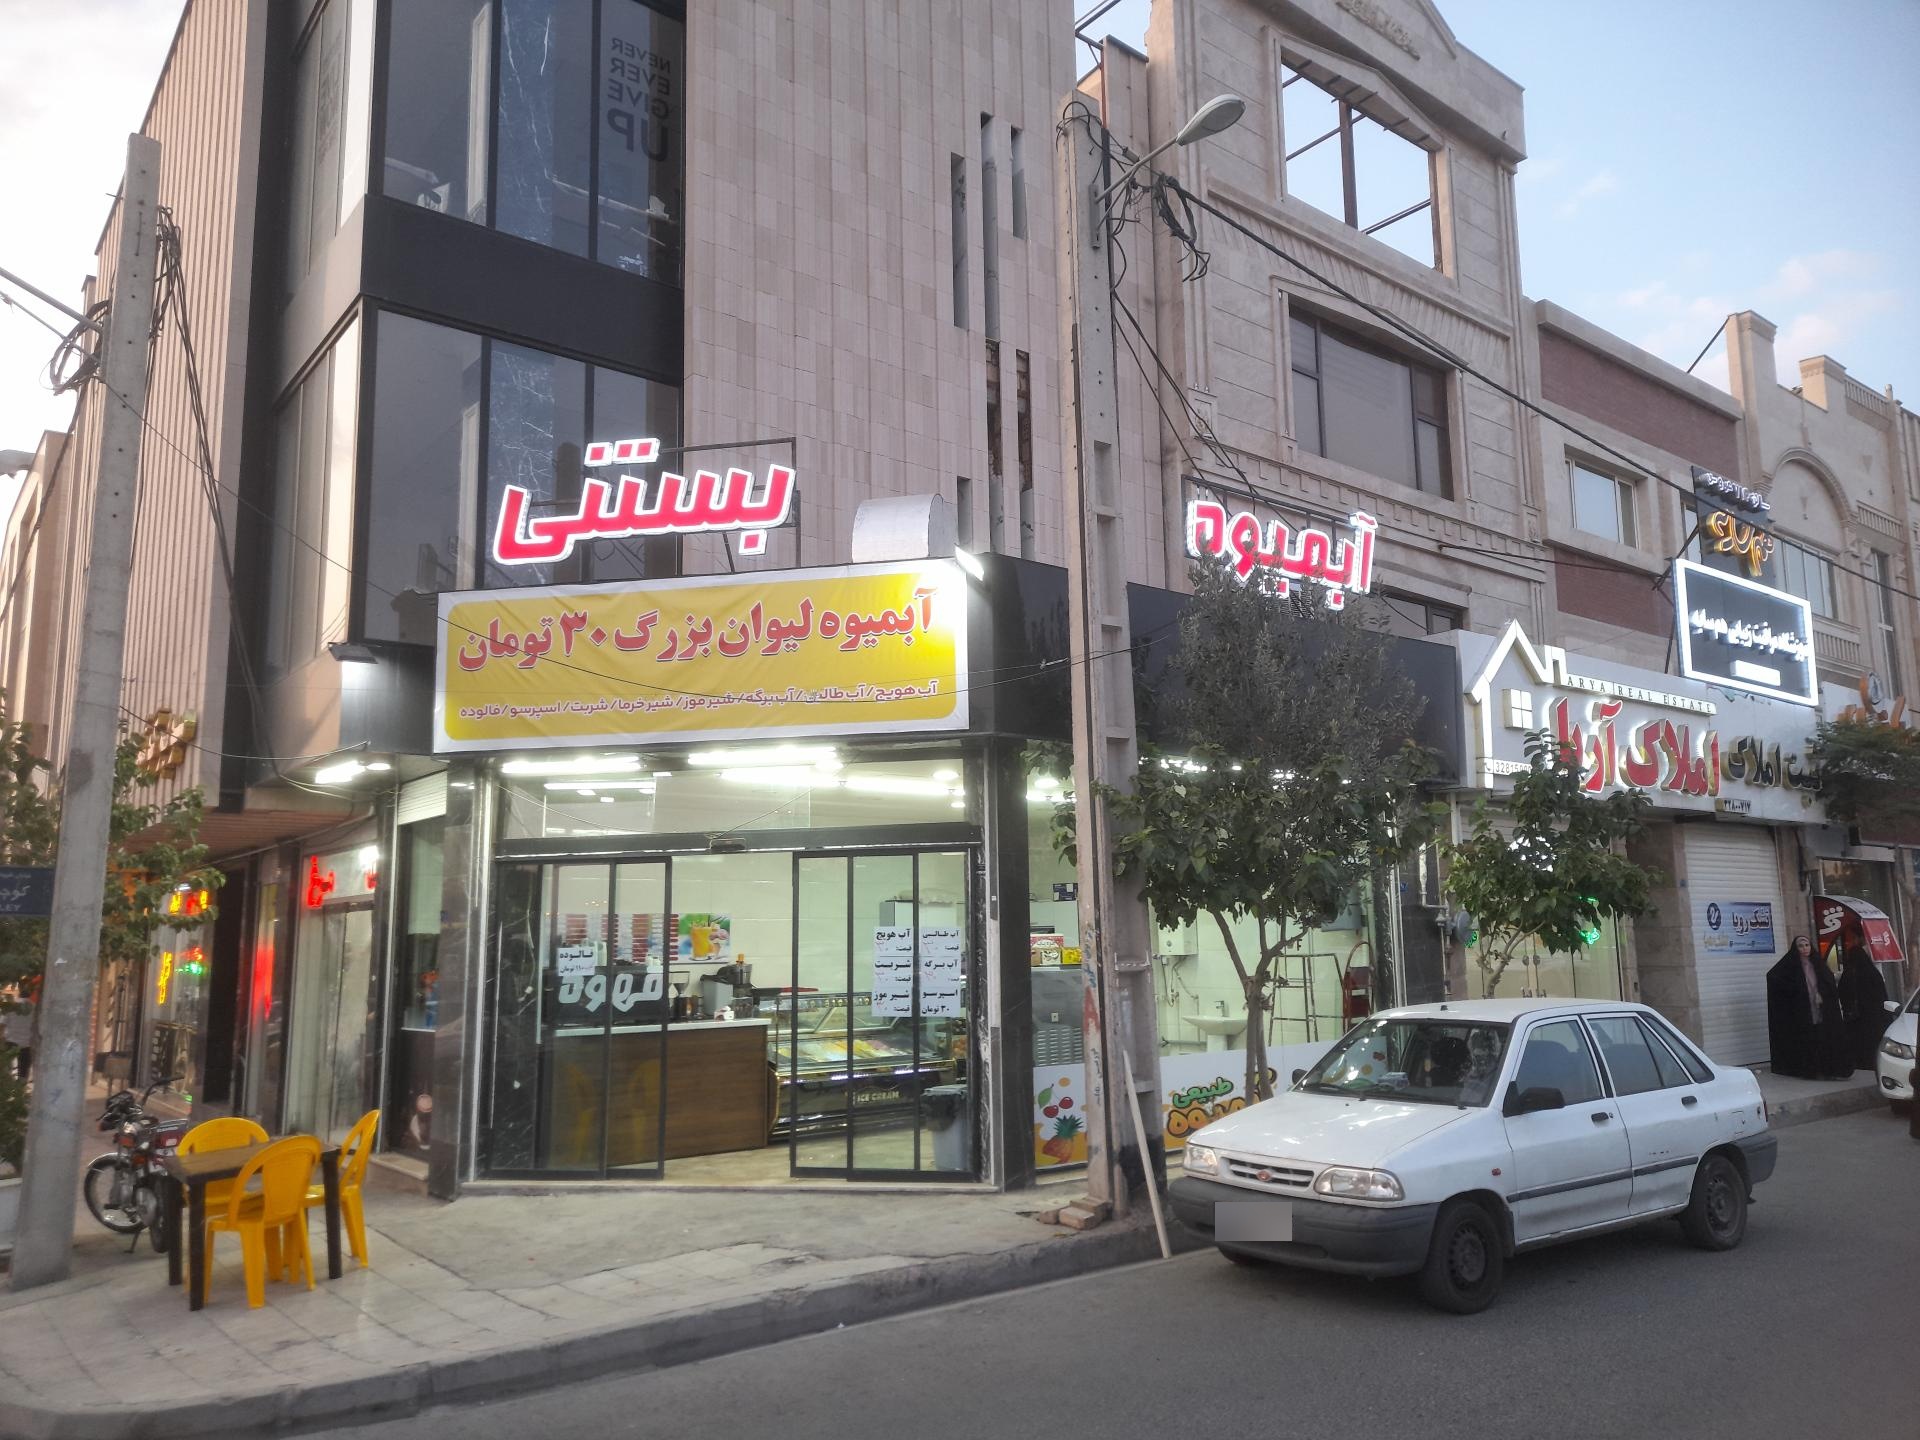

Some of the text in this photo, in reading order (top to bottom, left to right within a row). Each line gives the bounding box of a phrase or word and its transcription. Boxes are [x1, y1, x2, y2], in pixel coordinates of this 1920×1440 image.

[493, 437, 796, 565] بستنی
[1187, 500, 1379, 612] آبمیوه
[458, 616, 554, 671] تومان
[613, 609, 714, 662] بزرگ
[717, 596, 814, 657] لیوان
[818, 587, 938, 651] آبمیوه
[1567, 676, 1712, 713] ARYA REAL ESTATE
[1618, 717, 1720, 797] املاک
[559, 949, 594, 961] فالوده
[876, 928, 911, 941] آب هویج
[875, 959, 912, 971] شربت
[1172, 1076, 1234, 1109] طبیعی
